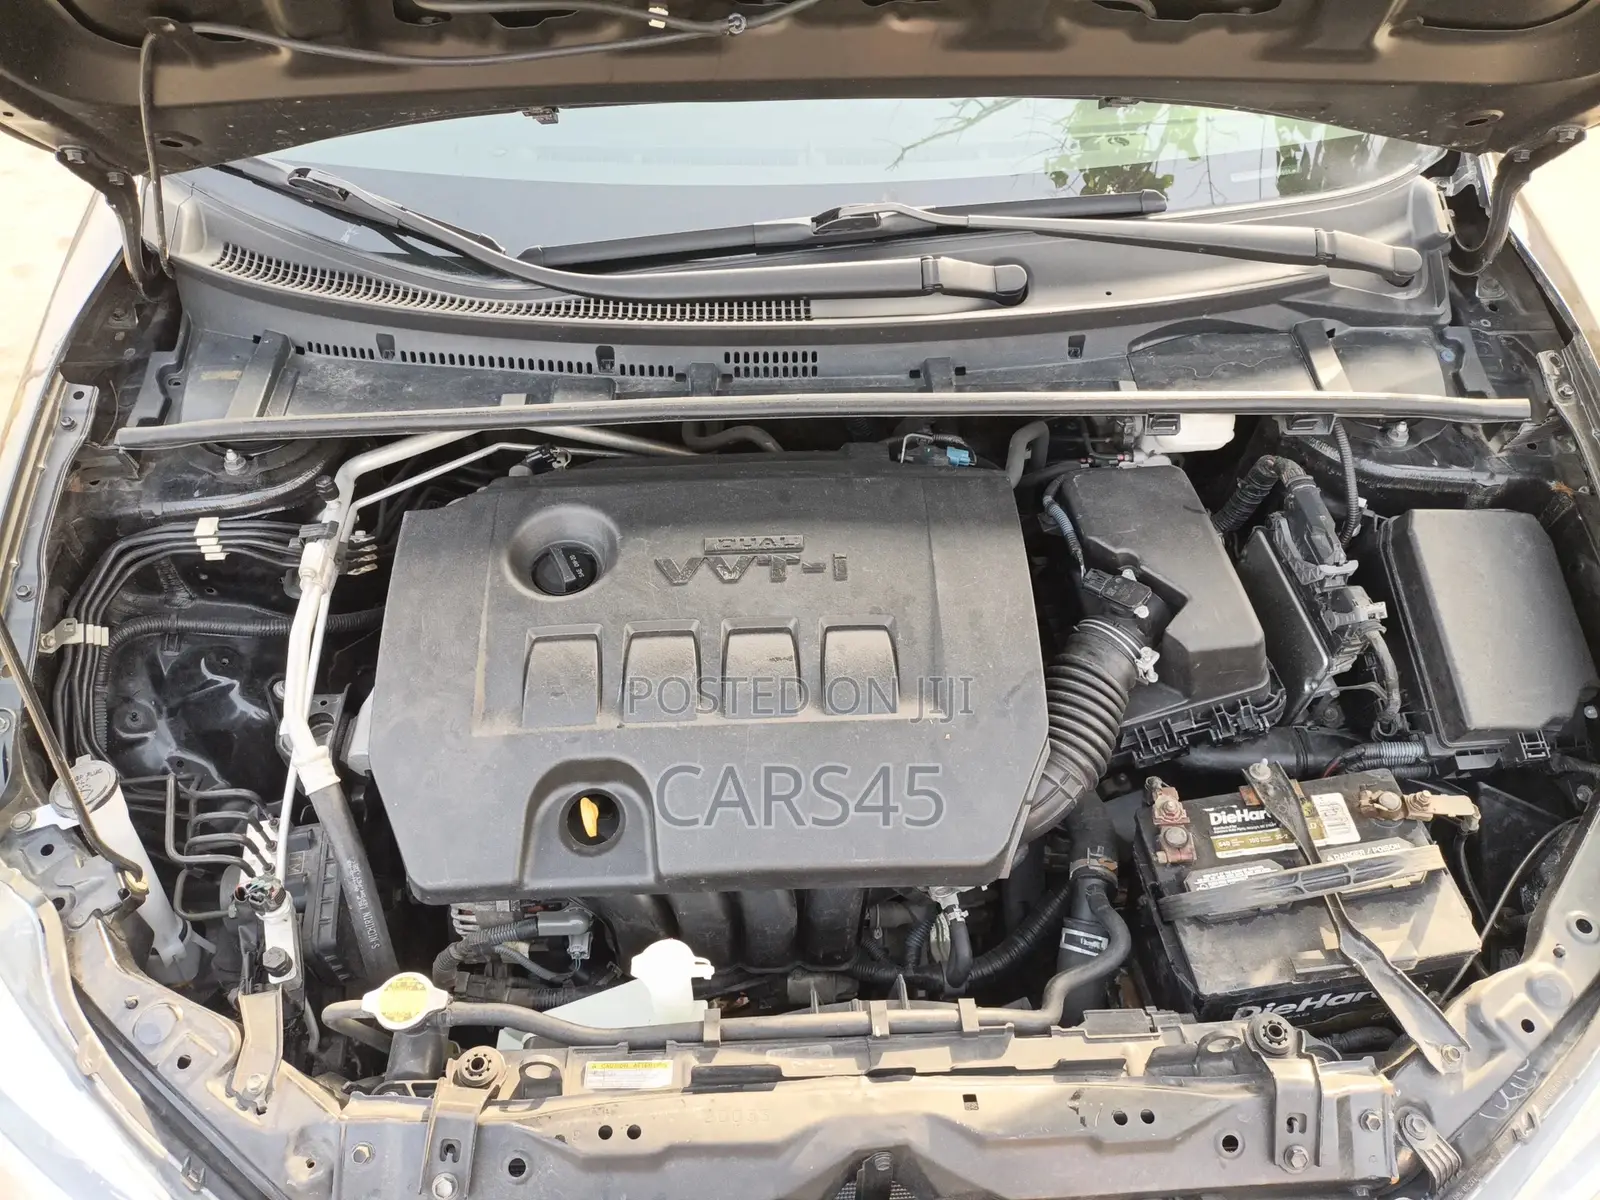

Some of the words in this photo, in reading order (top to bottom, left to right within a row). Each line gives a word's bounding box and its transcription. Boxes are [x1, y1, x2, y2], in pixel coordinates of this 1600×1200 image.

[1209, 808, 1272, 827] DieHar
[1333, 850, 1365, 861] DANGER
[1372, 843, 1401, 853] POISON
